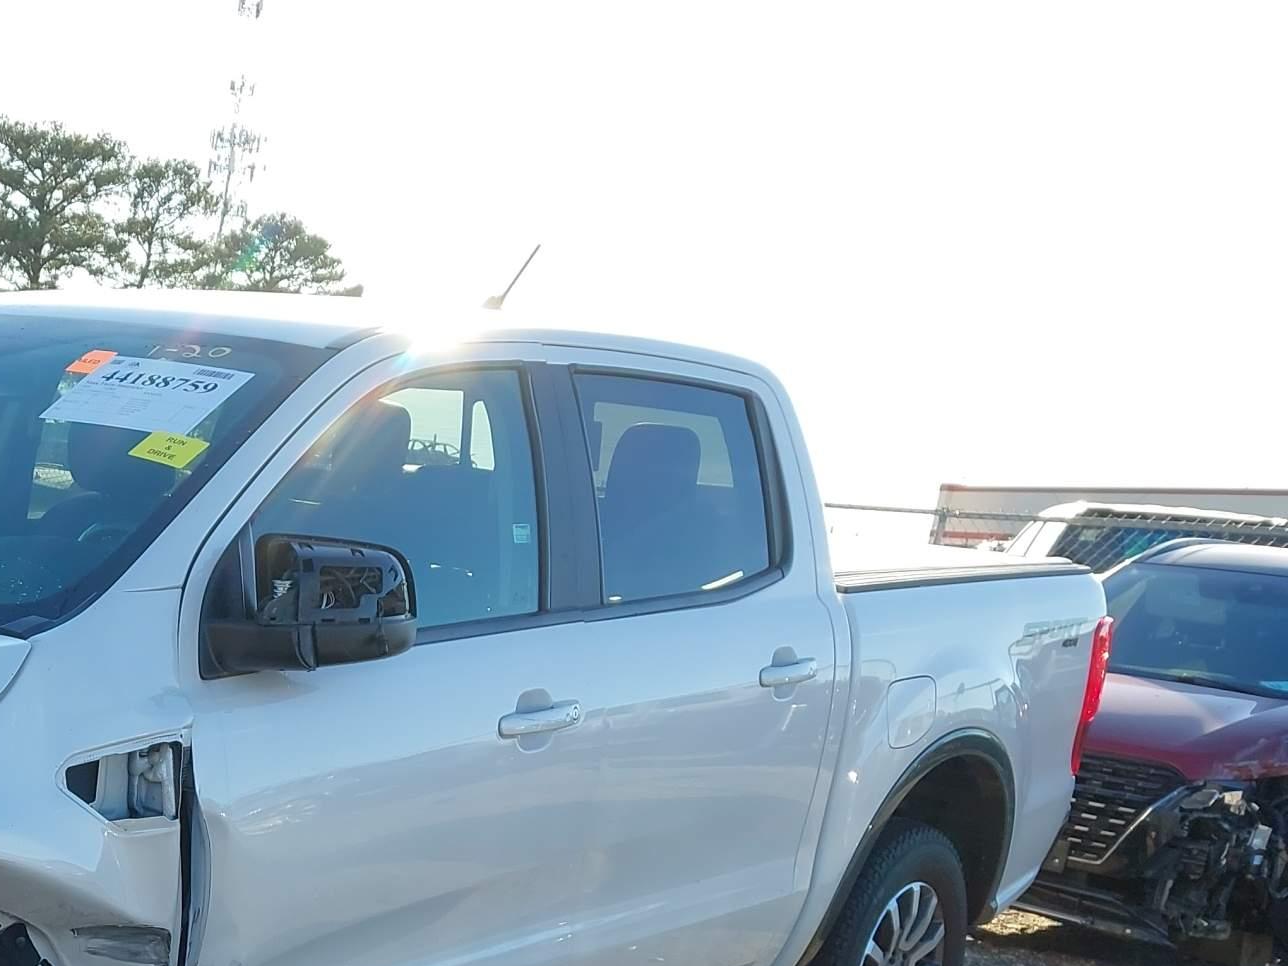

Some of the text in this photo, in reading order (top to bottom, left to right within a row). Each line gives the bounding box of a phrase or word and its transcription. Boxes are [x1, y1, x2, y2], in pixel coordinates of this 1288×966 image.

[101, 369, 220, 394] 44188759
[166, 436, 188, 446] RUN
[146, 448, 177, 461] DRIVE
